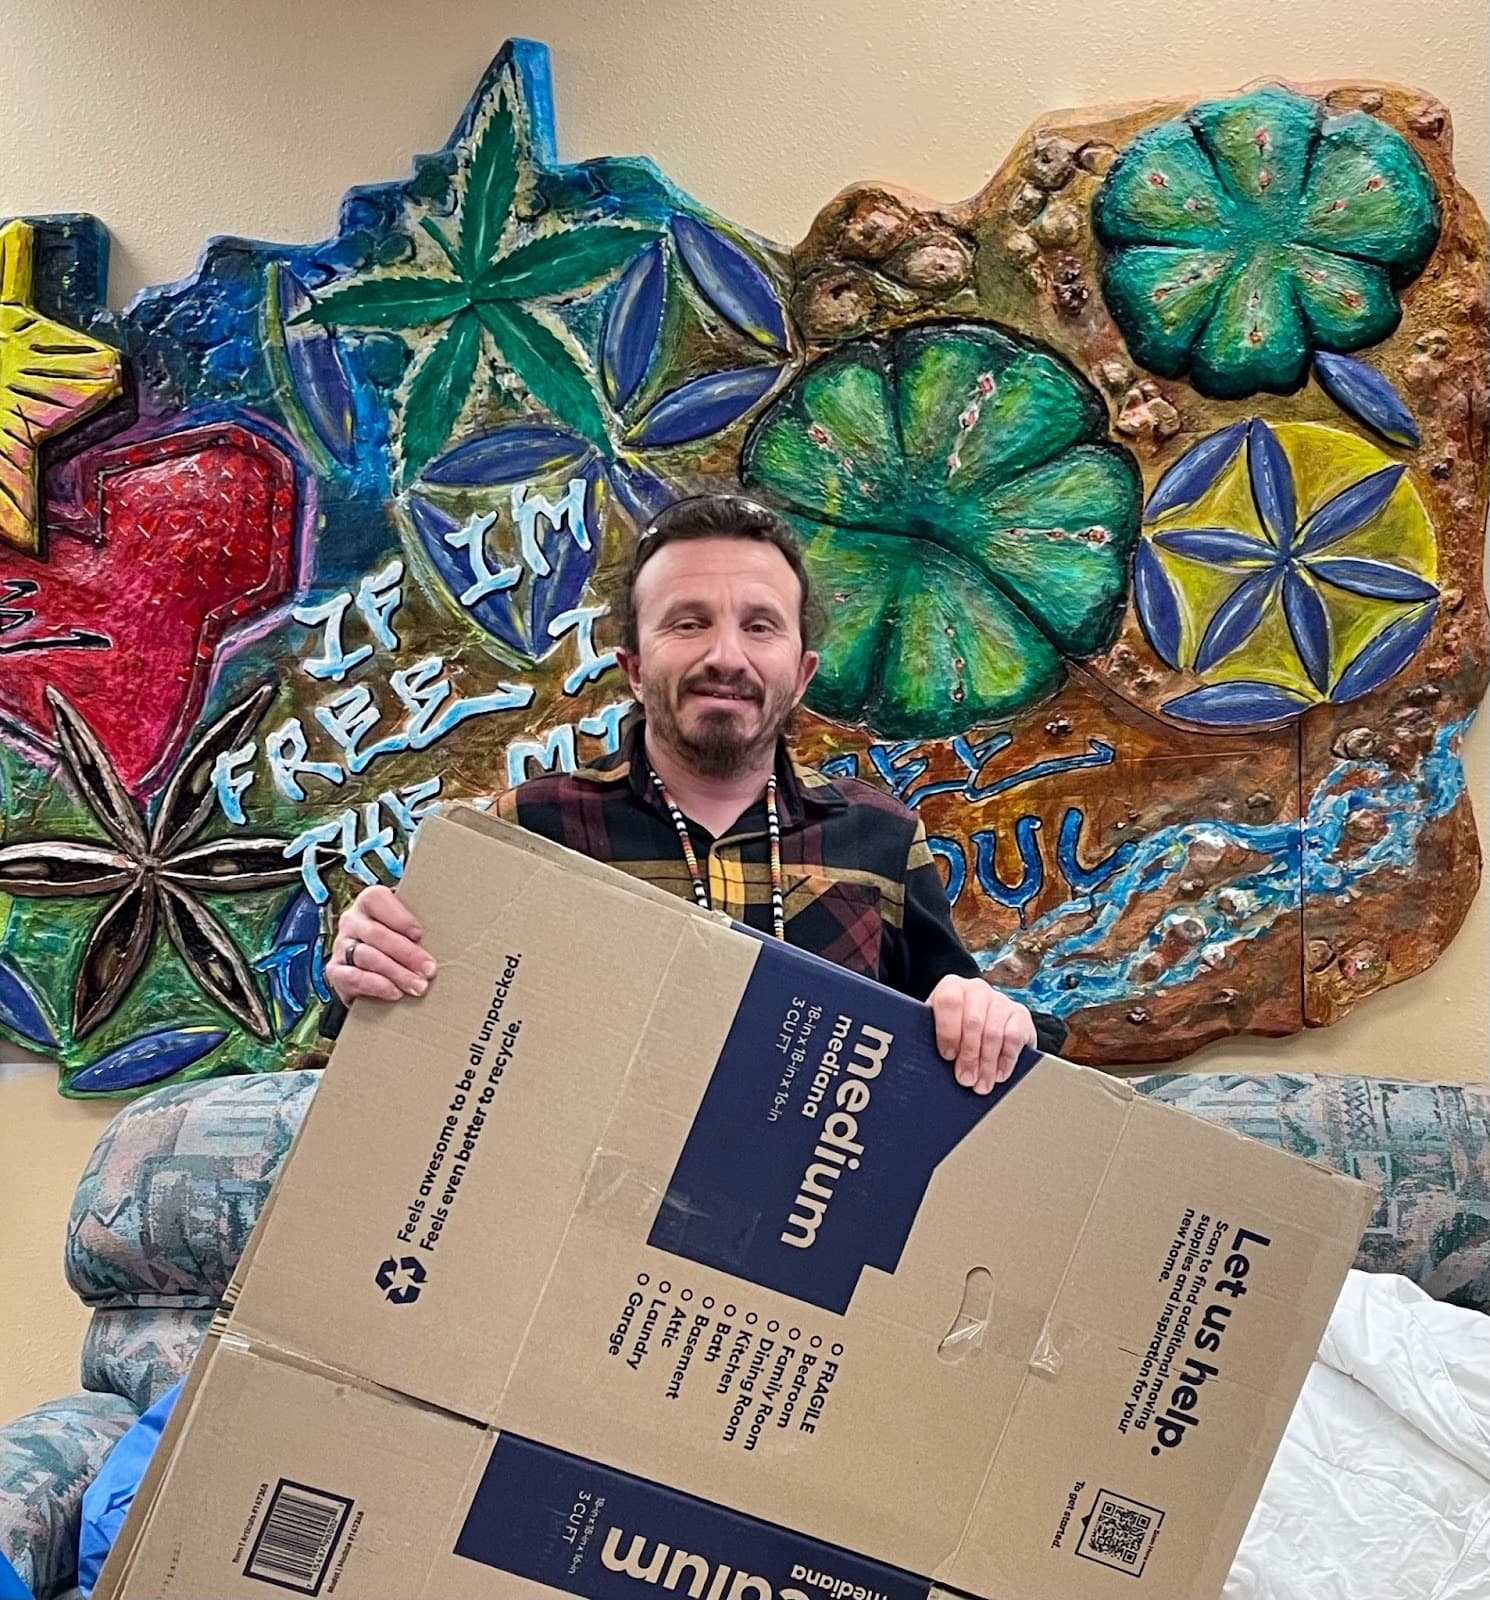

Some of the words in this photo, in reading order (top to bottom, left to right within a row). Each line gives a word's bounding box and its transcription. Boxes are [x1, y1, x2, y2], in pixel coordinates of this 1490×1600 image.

[293, 560, 405, 682] IF
[210, 656, 536, 826] FREE
[820, 732, 1115, 812] EE
[283, 775, 443, 906] THE
[507, 698, 636, 790] MY
[478, 953, 522, 1042] unpacked.
[792, 996, 806, 1009] 3
[782, 1009, 800, 1033] CU
[800, 1006, 823, 1036] 18-in
[469, 1042, 486, 1066] all
[487, 1019, 523, 1085] recycle.
[775, 1033, 792, 1054] FT
[783, 1048, 806, 1078] 18-in
[455, 1069, 476, 1092] be
[801, 1015, 853, 1119] mediana
[448, 1094, 466, 1112] to
[477, 1086, 495, 1104] to
[767, 1091, 789, 1122] 16-in
[419, 1115, 458, 1197] awesome
[453, 1106, 487, 1163] better
[780, 1024, 894, 1248] medium
[441, 1164, 467, 1205] even
[396, 1199, 426, 1243] Feels
[419, 1207, 449, 1252] Feels
[1176, 1208, 1195, 1240] new
[1181, 1213, 1211, 1272] supplies
[1205, 1220, 1229, 1256] Scan
[1158, 1239, 1186, 1283] home.
[1199, 1258, 1213, 1273] to
[1214, 1227, 1271, 1299] Let
[1169, 1273, 1187, 1303] and
[1185, 1275, 1207, 1305] find
[608, 1292, 644, 1356] Garage
[626, 1298, 667, 1371] Laundry
[661, 1306, 687, 1348] Attic
[704, 1322, 732, 1363] Bath
[1138, 1302, 1179, 1378] inspiration
[1156, 1305, 1192, 1379] additional
[1194, 1304, 1233, 1353] us
[665, 1314, 710, 1400] Basement
[716, 1329, 753, 1394] Kitchen
[739, 1337, 775, 1393] Dining
[761, 1345, 796, 1402] Family
[776, 1353, 818, 1429] Bedroom
[799, 1360, 839, 1435] FRAGILE
[1131, 1379, 1149, 1402] for
[1134, 1377, 1164, 1431] moving
[1150, 1357, 1219, 1457] help.
[722, 1394, 753, 1442] Room
[743, 1403, 774, 1451] Room
[1117, 1401, 1137, 1435] your
[578, 1490, 592, 1501] 3
[1065, 1492, 1078, 1511] get
[1073, 1481, 1086, 1493] To
[562, 1525, 578, 1544] FT
[569, 1502, 586, 1525] CU
[1050, 1510, 1071, 1549] started.
